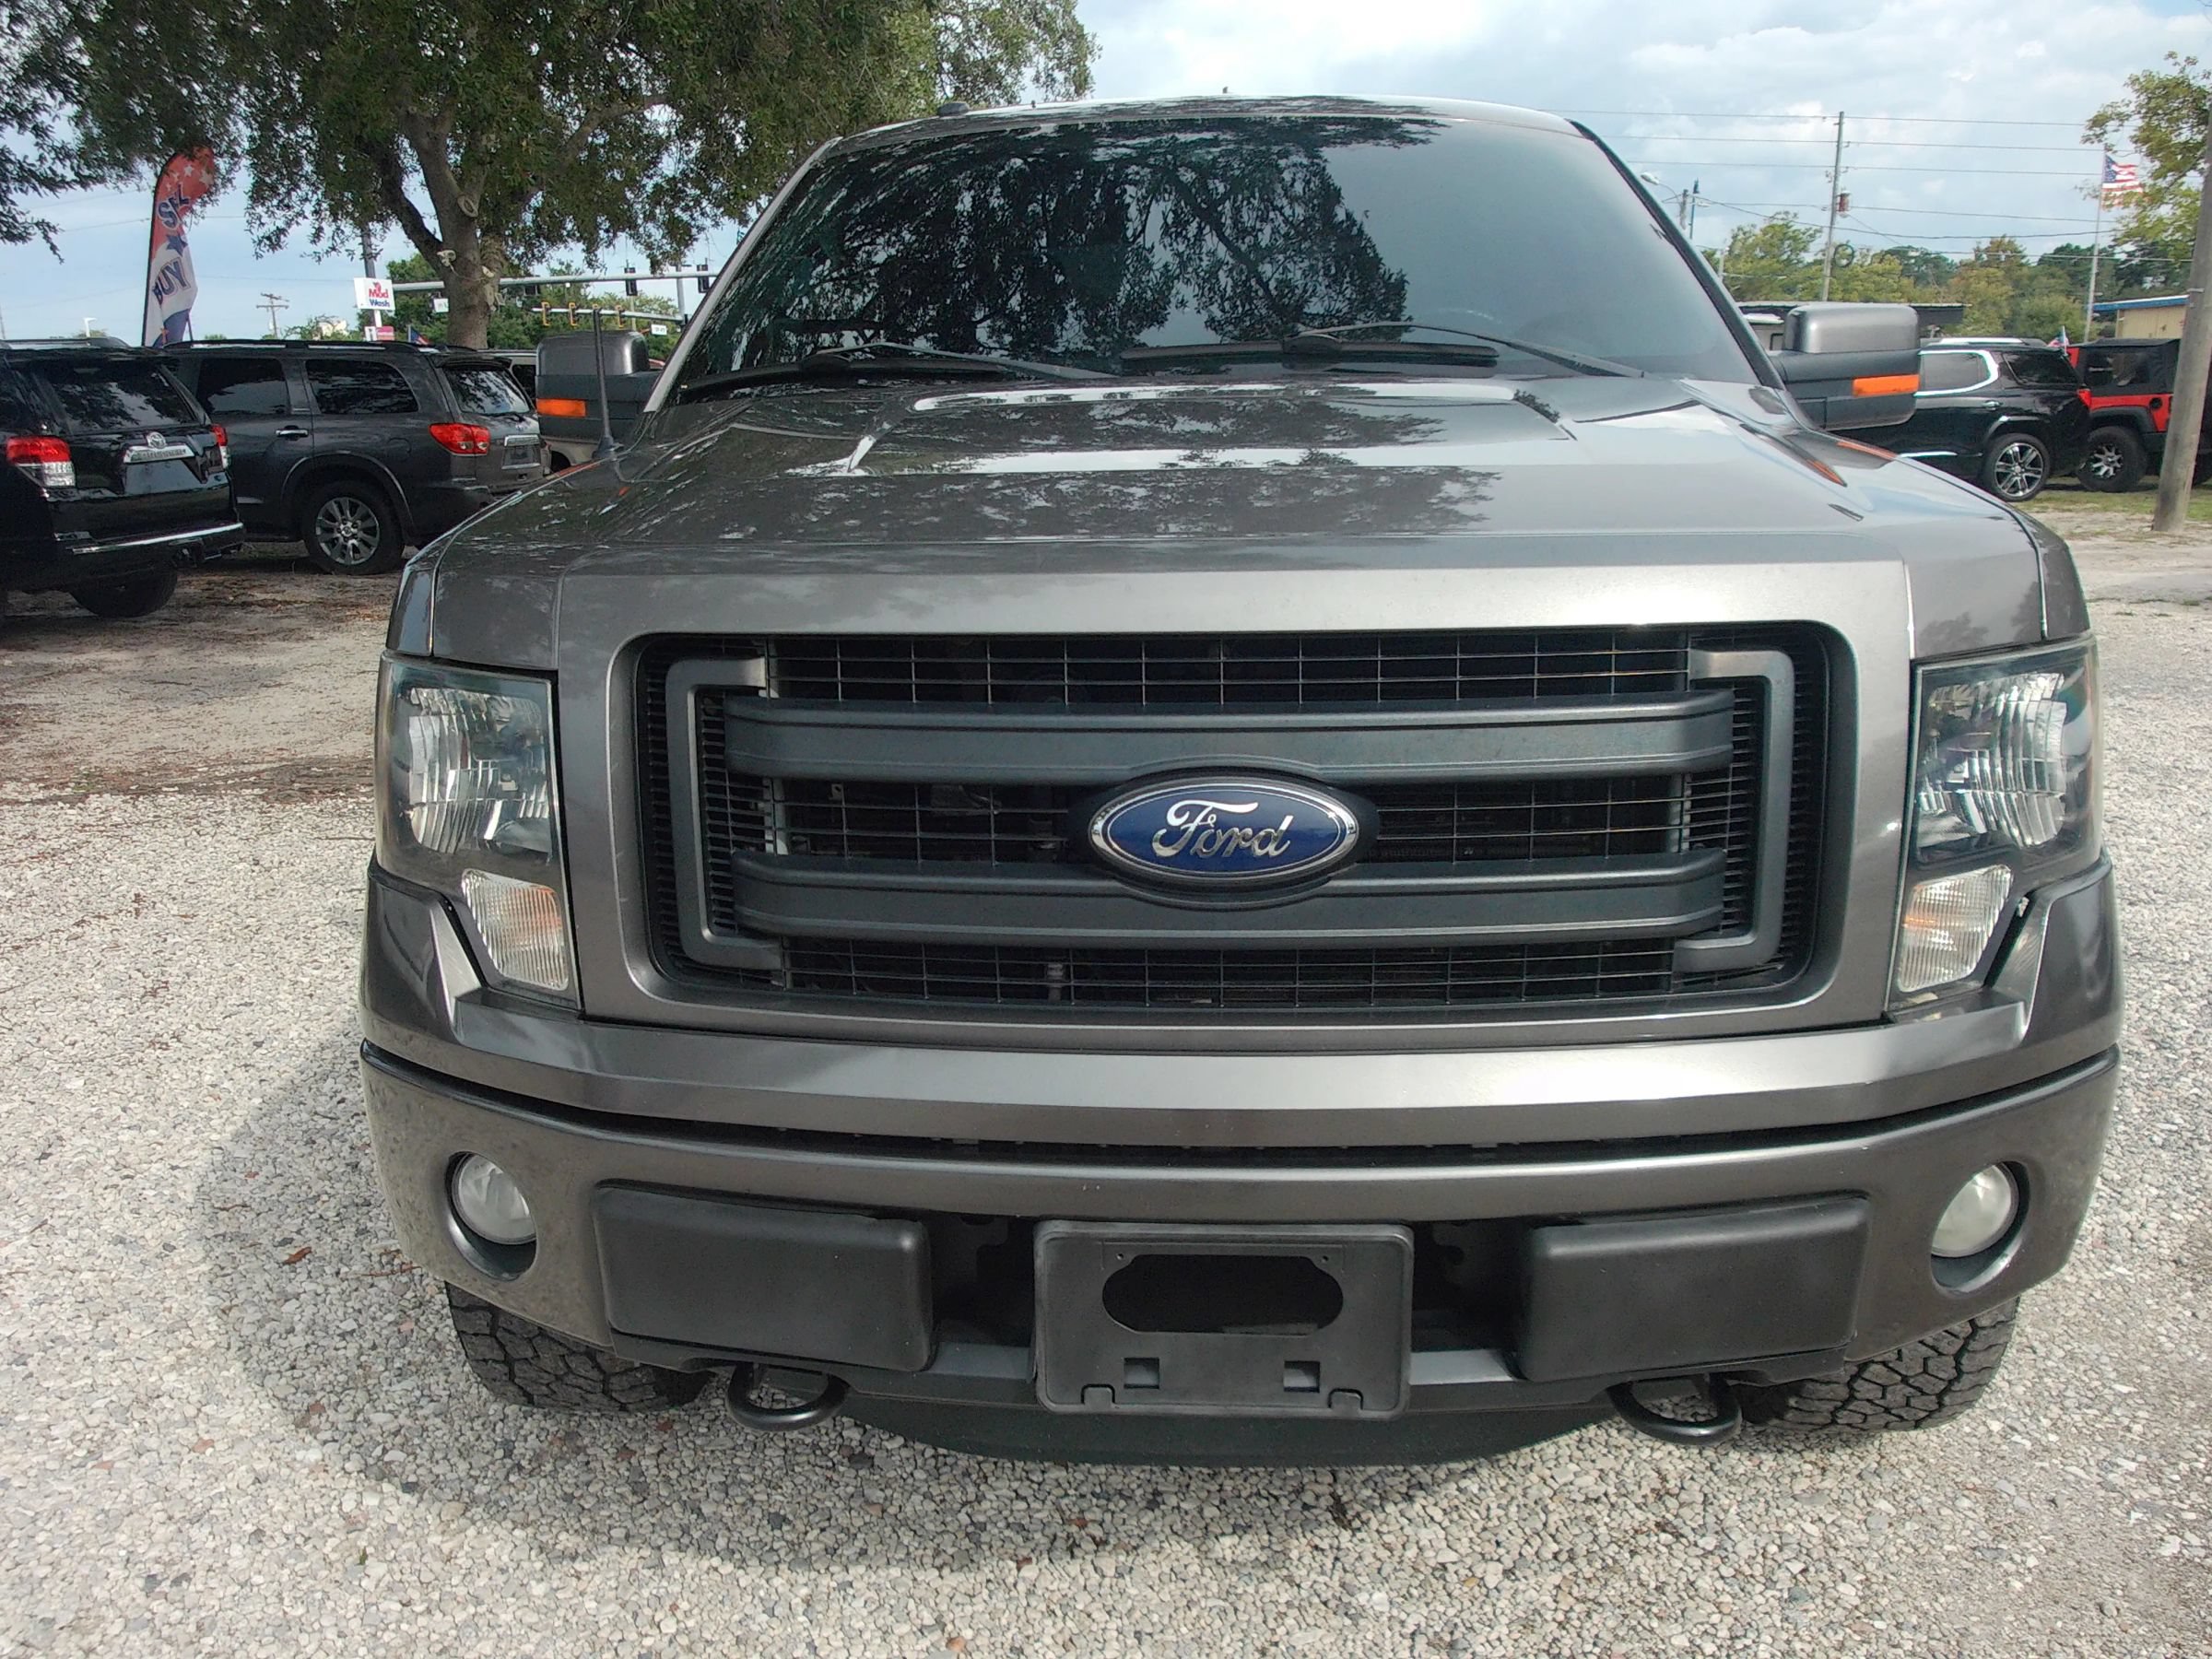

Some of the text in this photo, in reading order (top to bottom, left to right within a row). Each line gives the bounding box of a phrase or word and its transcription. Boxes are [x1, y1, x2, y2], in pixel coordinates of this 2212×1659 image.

[152, 257, 190, 306] BUY
[369, 299, 390, 307] Wash
[1151, 799, 1294, 858] Ford
